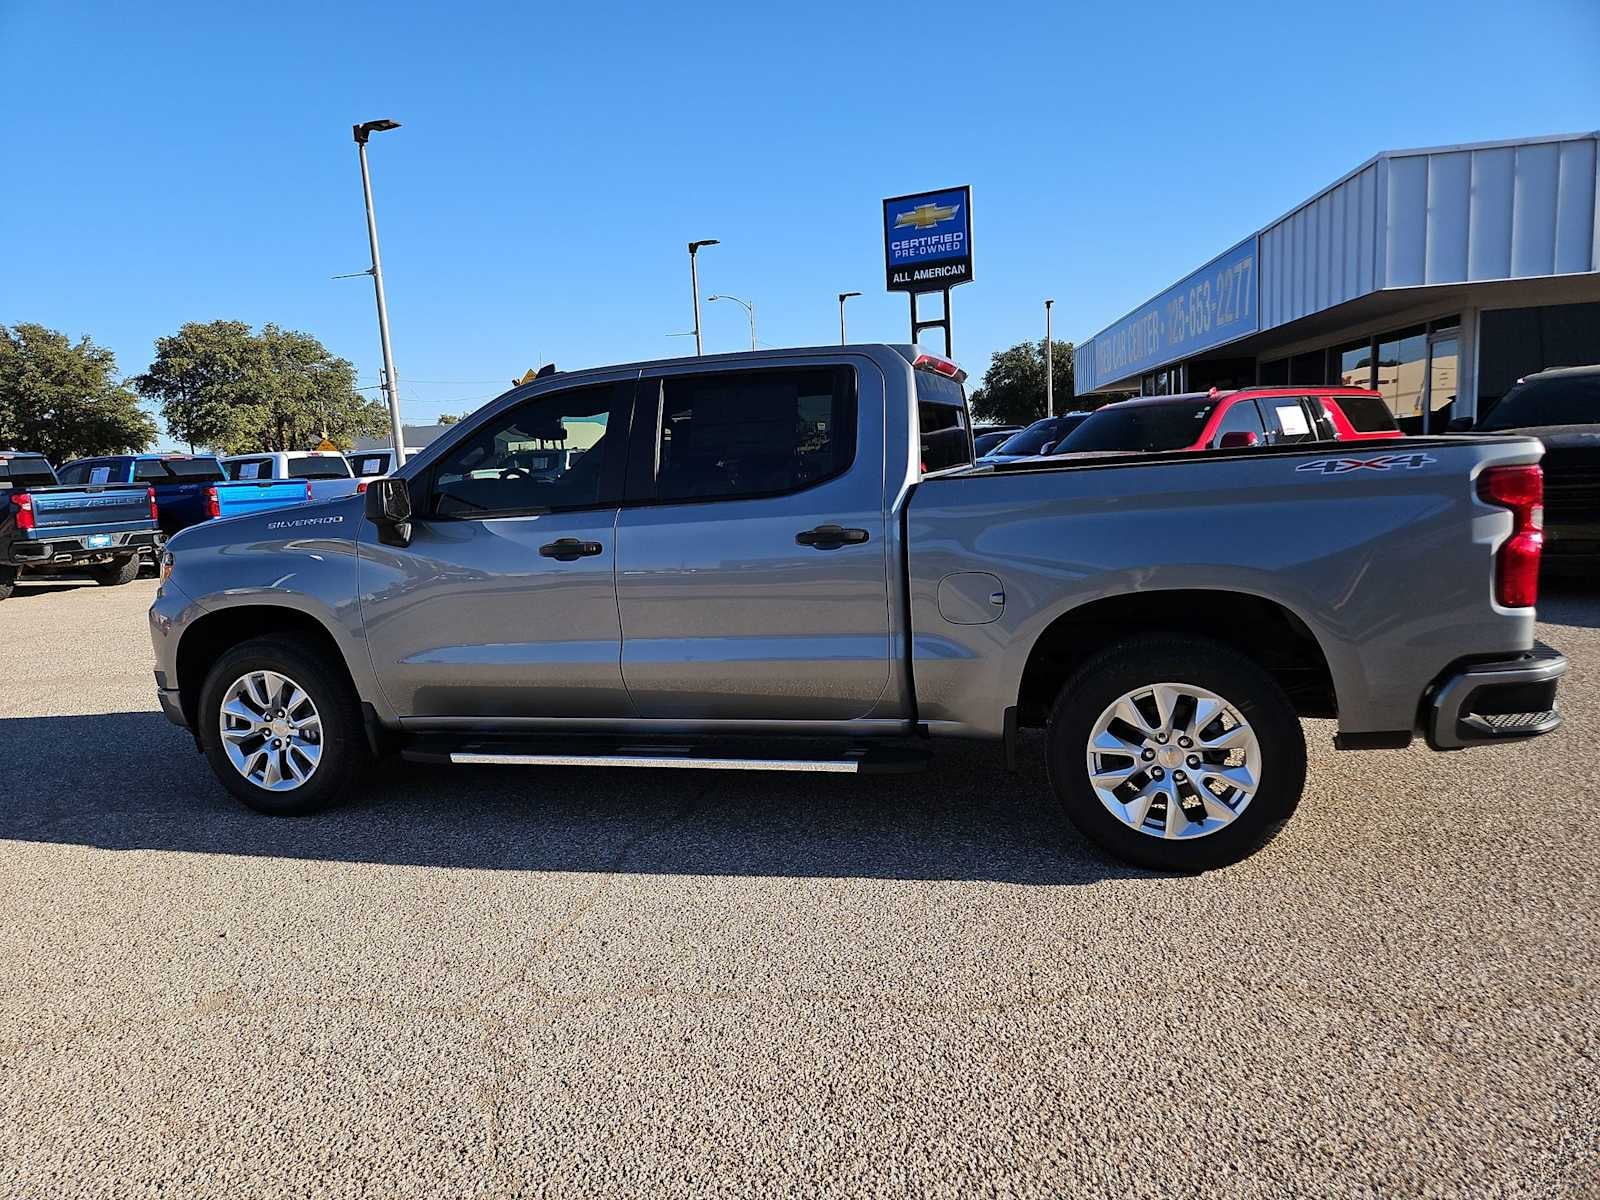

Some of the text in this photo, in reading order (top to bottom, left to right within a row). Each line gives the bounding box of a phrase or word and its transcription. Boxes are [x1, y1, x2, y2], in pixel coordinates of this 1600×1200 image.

[891, 232, 963, 250] CERTIFIED
[895, 241, 960, 258] PRE-OWNED
[893, 264, 965, 283] ALL AMERICAN
[1128, 310, 1159, 363] CETER
[1167, 256, 1253, 346] 25-653-2277
[267, 516, 344, 530] SILVERADO
